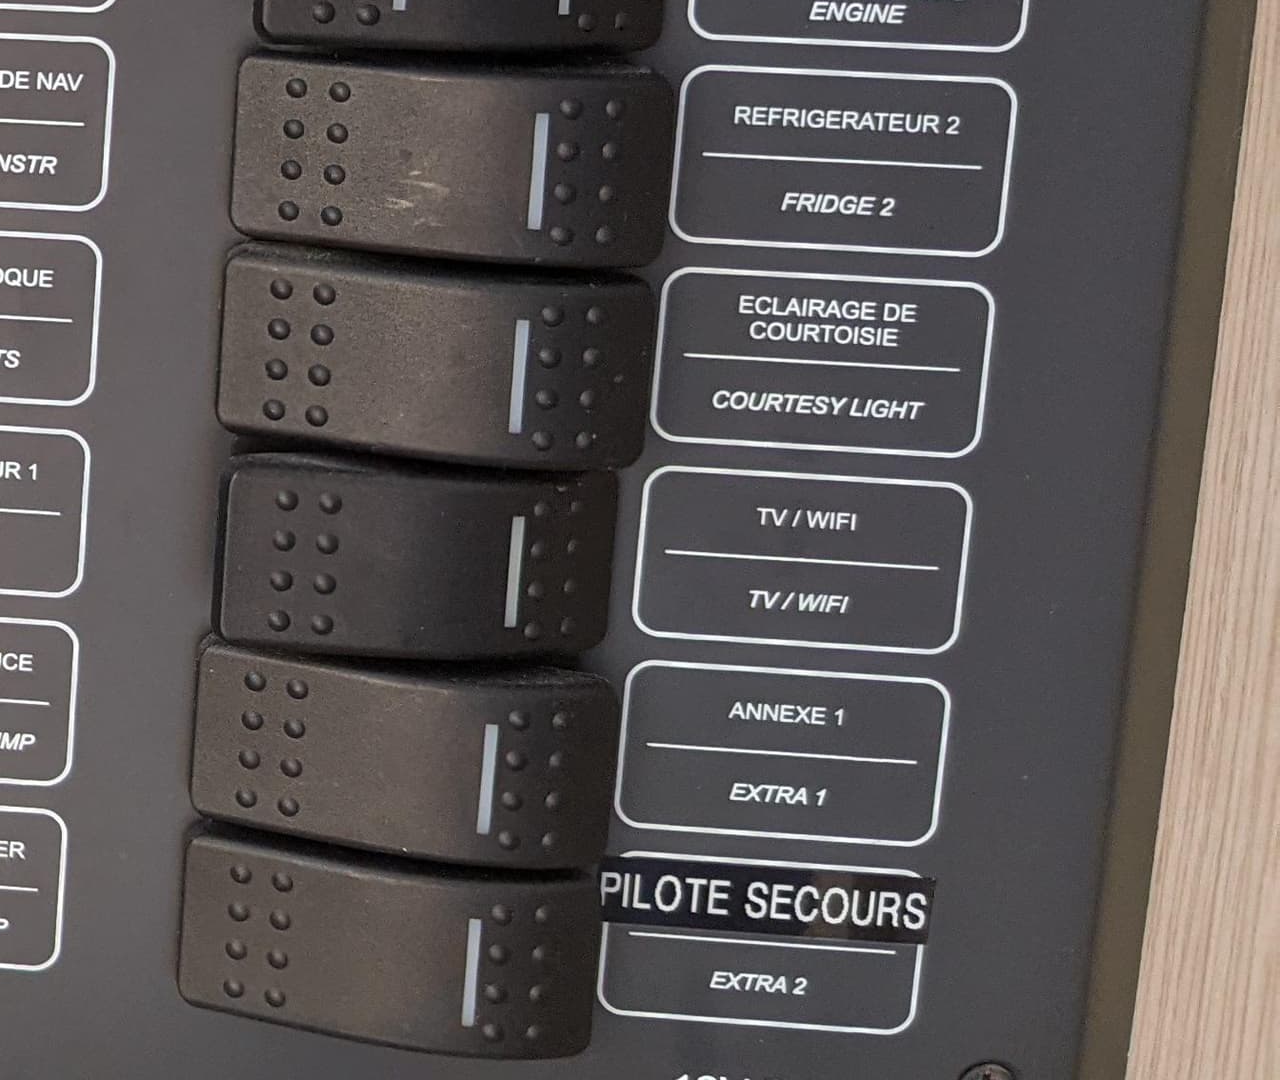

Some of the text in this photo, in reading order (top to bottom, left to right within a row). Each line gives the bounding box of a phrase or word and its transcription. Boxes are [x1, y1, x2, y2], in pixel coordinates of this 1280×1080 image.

[809, 1, 907, 24] ENGINE
[36, 71, 84, 92] NAV
[734, 105, 961, 135] REFRIGERATEUR 2
[780, 192, 896, 217] FRIDGE 2
[738, 295, 918, 323] ECLAIRAGE DE
[749, 320, 899, 347] COURTOISIE
[712, 390, 926, 420] COURTESY LIGHT
[28, 463, 37, 481] 1
[756, 507, 857, 531] TV / WIFI
[749, 589, 849, 614] TV / WIFI
[728, 701, 844, 726] ANNEXE 1
[729, 782, 827, 807] EXTRA 1
[600, 871, 928, 930] PILOTE SECOURS
[709, 971, 808, 995] EXTRA 2
